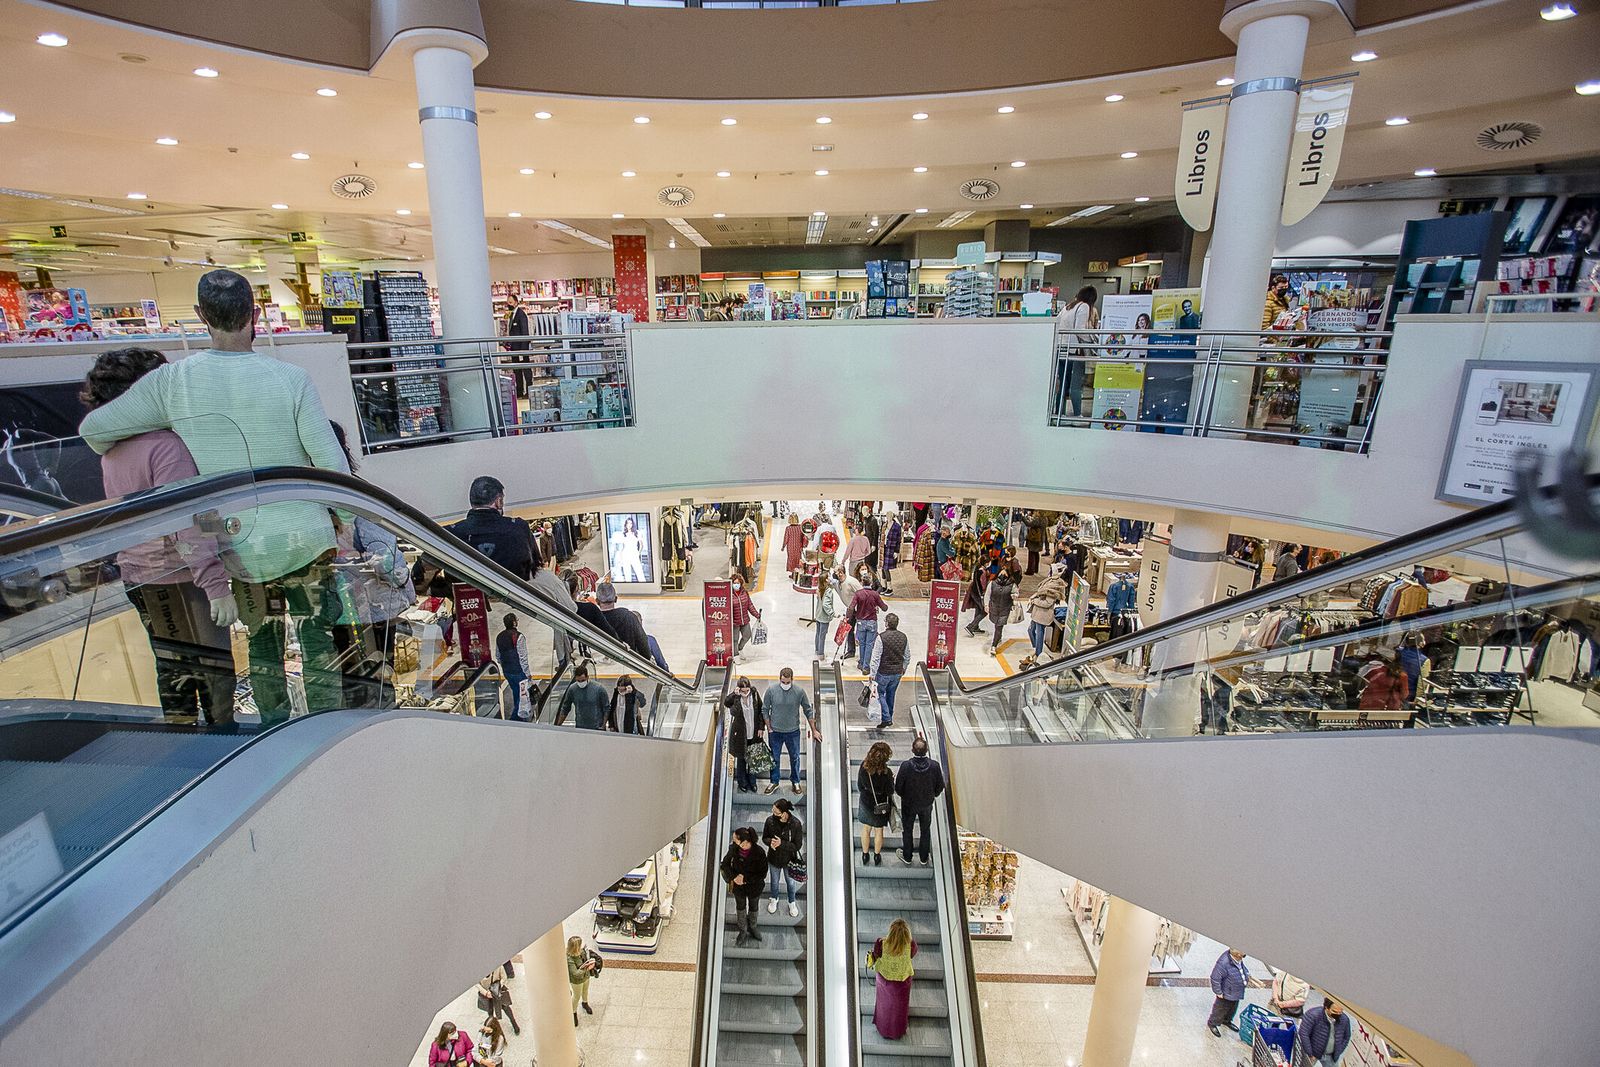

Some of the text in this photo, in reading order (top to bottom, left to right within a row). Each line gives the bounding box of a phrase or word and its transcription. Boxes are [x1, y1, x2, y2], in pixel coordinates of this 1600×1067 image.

[1299, 112, 1329, 186] Libros
[1186, 129, 1210, 196] Libros
[1487, 437, 1513, 446] CORTE
[1145, 560, 1161, 611] Joven El
[936, 602, 953, 610] 2022
[708, 611, 729, 620] -40%
[933, 612, 955, 623] -40%
